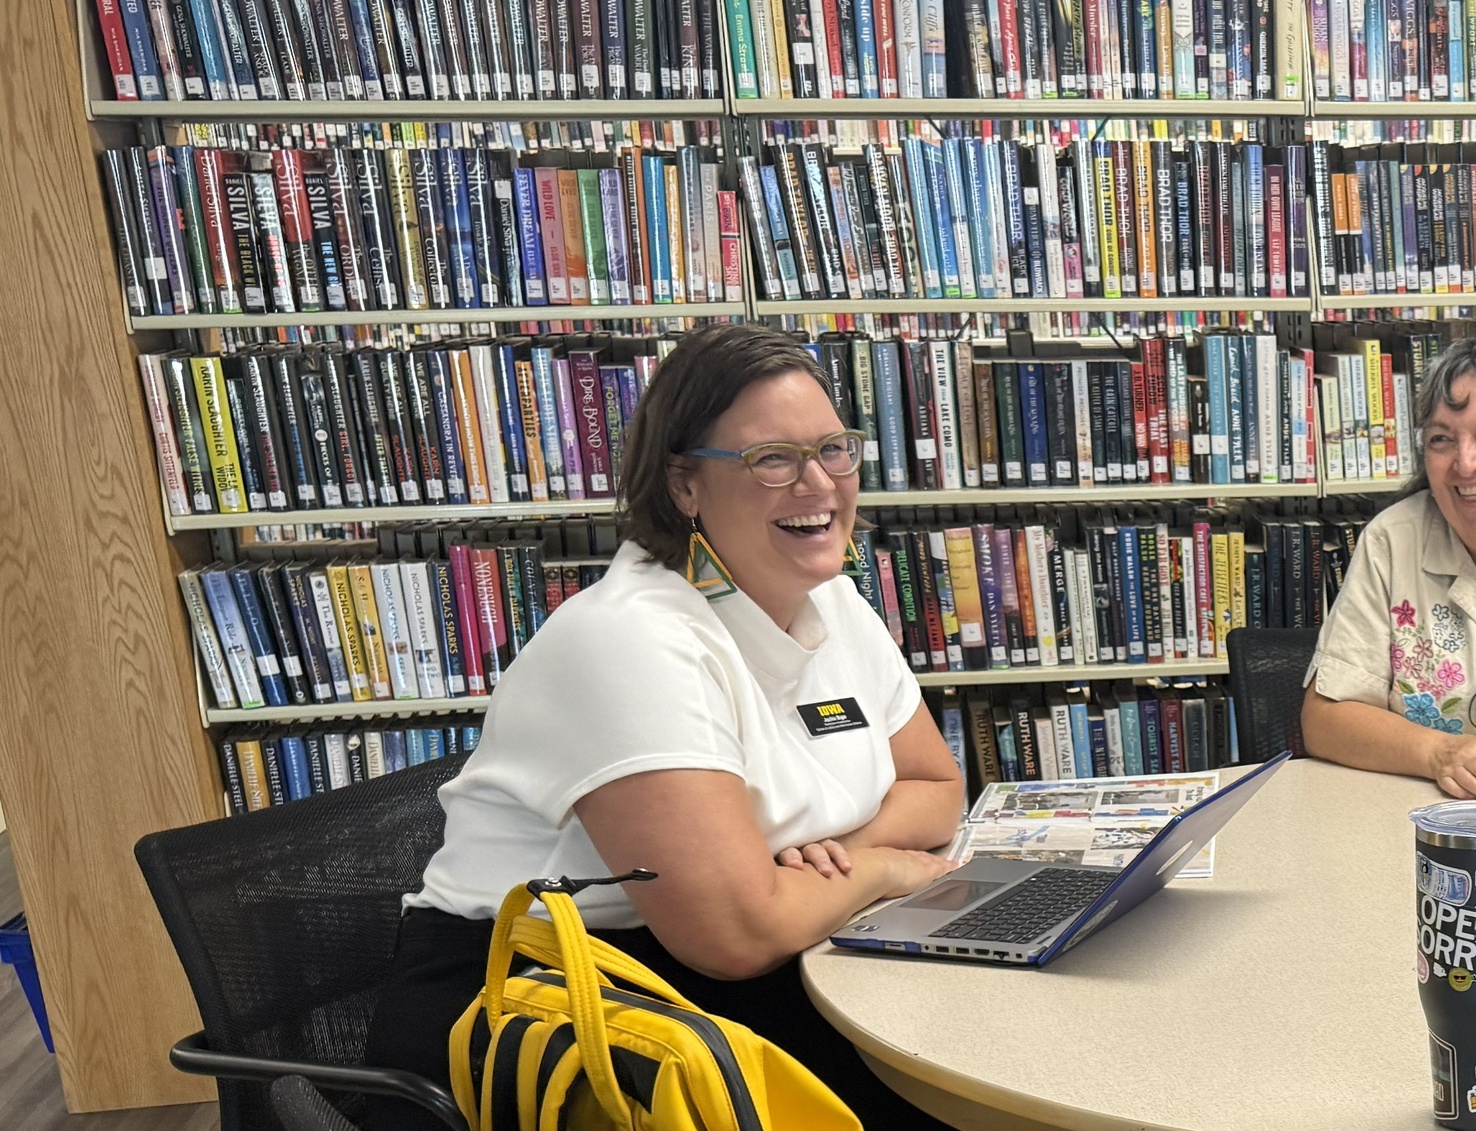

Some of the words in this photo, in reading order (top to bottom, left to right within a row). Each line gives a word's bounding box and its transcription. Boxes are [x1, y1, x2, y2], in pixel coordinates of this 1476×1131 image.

[735, 13, 745, 41] Emma
[925, 5, 938, 33] Cliffs
[276, 162, 303, 217] Silva
[327, 162, 352, 215] Silva
[357, 162, 382, 216] Silva
[415, 162, 438, 209] Silva
[467, 163, 487, 207] Silva
[542, 179, 553, 200] WILD
[1157, 169, 1170, 206] BRAD
[1178, 181, 1189, 208] BRAD
[255, 186, 277, 230] SILVA
[307, 184, 332, 230] SILVA
[545, 201, 556, 221] LOVE
[227, 186, 249, 231] SILVA
[240, 249, 253, 274] BLACK
[1160, 207, 1173, 242] THOR
[1179, 210, 1190, 236] THOR
[416, 362, 423, 375] WE
[859, 356, 868, 368] BIG
[935, 349, 945, 364] THE
[1168, 360, 1177, 377] END
[419, 376, 427, 397] ARE
[860, 369, 870, 393] STONE
[937, 366, 947, 387] VIEW
[1177, 365, 1186, 385] LAST
[1371, 358, 1379, 390] SHERRYL
[422, 399, 431, 416] ALL
[517, 366, 537, 439] AFTERPARTIES
[605, 385, 617, 424] FORGET
[863, 395, 871, 410] GAP
[1134, 381, 1144, 412] TURNER
[1372, 393, 1380, 421] WOODS
[206, 399, 228, 457] SLAUGHTER
[438, 391, 451, 442] CASSANDRA
[918, 405, 928, 436] ADRIANA
[940, 403, 950, 422] LAKE
[1158, 408, 1167, 425] THE
[1170, 400, 1180, 432] WORLD
[1231, 408, 1240, 431] ANNE
[943, 425, 952, 448] COMO
[1149, 416, 1159, 441] TRIAL
[1159, 426, 1168, 449] LAST
[1232, 434, 1240, 462] TYLER
[1196, 530, 1205, 542] THE
[1215, 542, 1227, 555] THE
[1053, 554, 1065, 594] MERGE
[1159, 564, 1169, 587] GONE
[1196, 543, 1207, 586] SATISFACTION
[1233, 567, 1241, 587] WARD
[438, 566, 453, 618] NICHOLAS
[474, 560, 498, 623] NONESUCH
[863, 572, 873, 600] Night
[1127, 555, 1135, 580] WALSH
[1132, 624, 1140, 640] LIFE
[1215, 559, 1228, 605] JETSETTERS
[411, 572, 424, 618] NICHOLAS
[418, 617, 429, 645] SPARKS
[902, 584, 917, 622] CONDITION
[338, 582, 353, 636] NICHOLAS
[348, 636, 361, 667] SPARKS
[445, 620, 458, 655] SPARKS
[817, 704, 845, 716] IOWA
[1056, 710, 1066, 739] RUTH
[976, 711, 988, 744] RUTH
[1018, 712, 1030, 742] RUTH
[1146, 720, 1157, 755] TOURIST
[1168, 722, 1178, 758] HARVEST
[266, 748, 280, 784] DANIELLE
[981, 746, 995, 778] WARE
[1022, 745, 1036, 776] WARE
[1060, 742, 1072, 774] WARE
[224, 745, 238, 783] DANIELLE
[232, 785, 243, 807] STEEL
